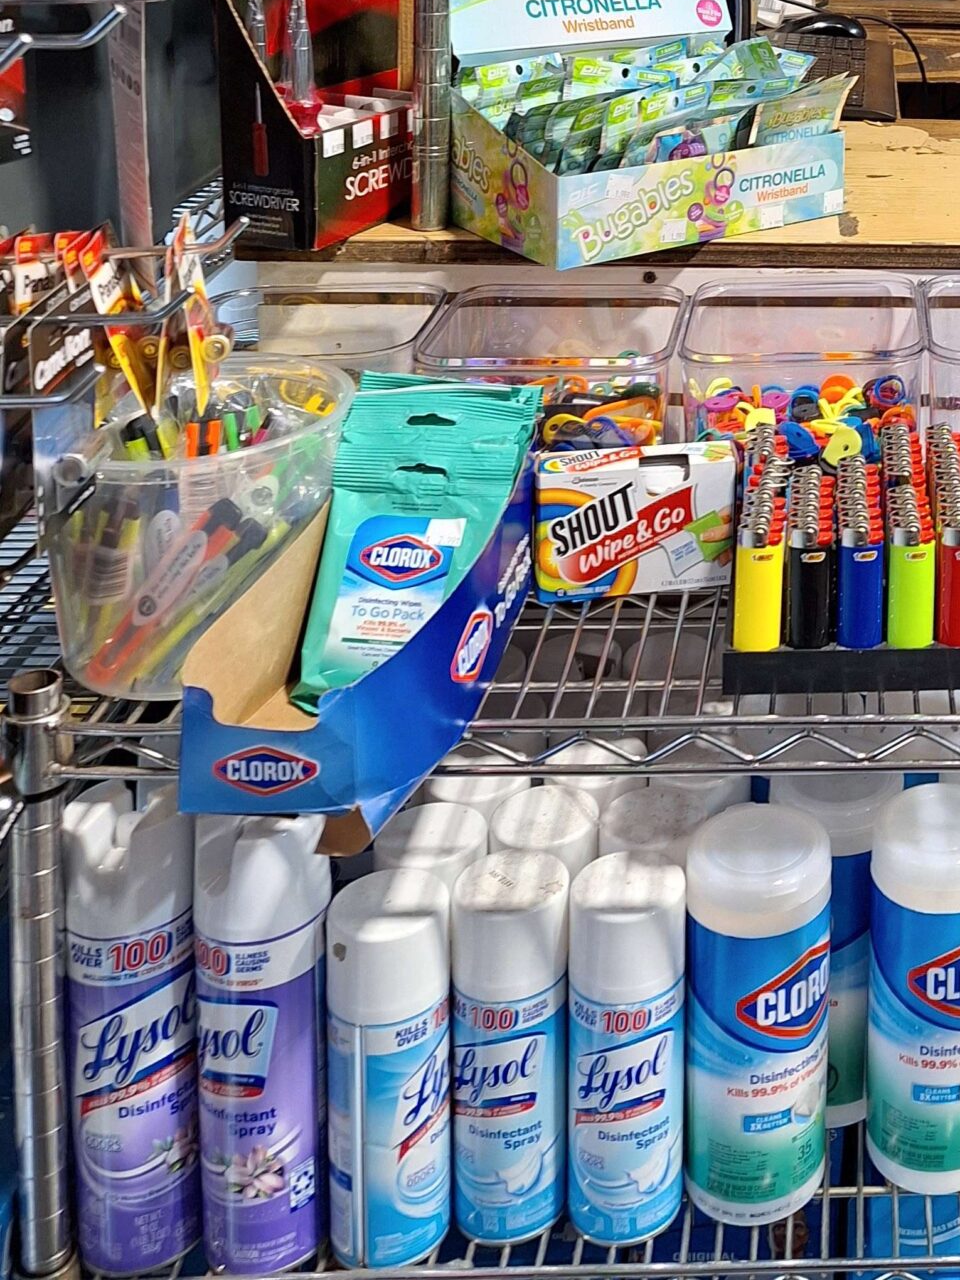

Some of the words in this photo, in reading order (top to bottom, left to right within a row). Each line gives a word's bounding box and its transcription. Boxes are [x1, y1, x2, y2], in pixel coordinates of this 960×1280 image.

[562, 15, 635, 34] Wristband
[739, 163, 826, 193] CITRONELLA
[228, 191, 300, 212] SCREWDRIVER
[756, 183, 809, 204] Wristband
[571, 167, 695, 263] Bugables
[560, 450, 601, 467] SHOUT
[551, 481, 634, 557] SHOUT
[369, 546, 433, 569] CLOROX
[351, 605, 368, 617] To
[369, 605, 390, 618] Go
[392, 607, 425, 620] Pack
[226, 758, 306, 782] CLOROX
[71, 942, 103, 957] KILLS
[109, 931, 172, 974] 100
[73, 954, 103, 969] OVER
[756, 954, 830, 1027] CLORO
[80, 972, 198, 1085] Lysol
[394, 1019, 428, 1040] KILLS
[471, 1006, 519, 1032] 100
[602, 1008, 652, 1034] 100
[397, 1028, 428, 1048] OVER
[454, 1038, 538, 1104] Lysol
[578, 1035, 668, 1110] Lysol
[749, 1046, 819, 1086] Disinfecting
[899, 1054, 919, 1068] Kills
[921, 1056, 958, 1070] 99.9%
[727, 1086, 749, 1099] Kills
[750, 1082, 788, 1098] 99.9%
[469, 1120, 543, 1140] Disinfectant
[598, 1116, 670, 1142] Disinfectant
[636, 1128, 670, 1150] Spray
[504, 1131, 542, 1151] Spray
[797, 1139, 813, 1160] 35
